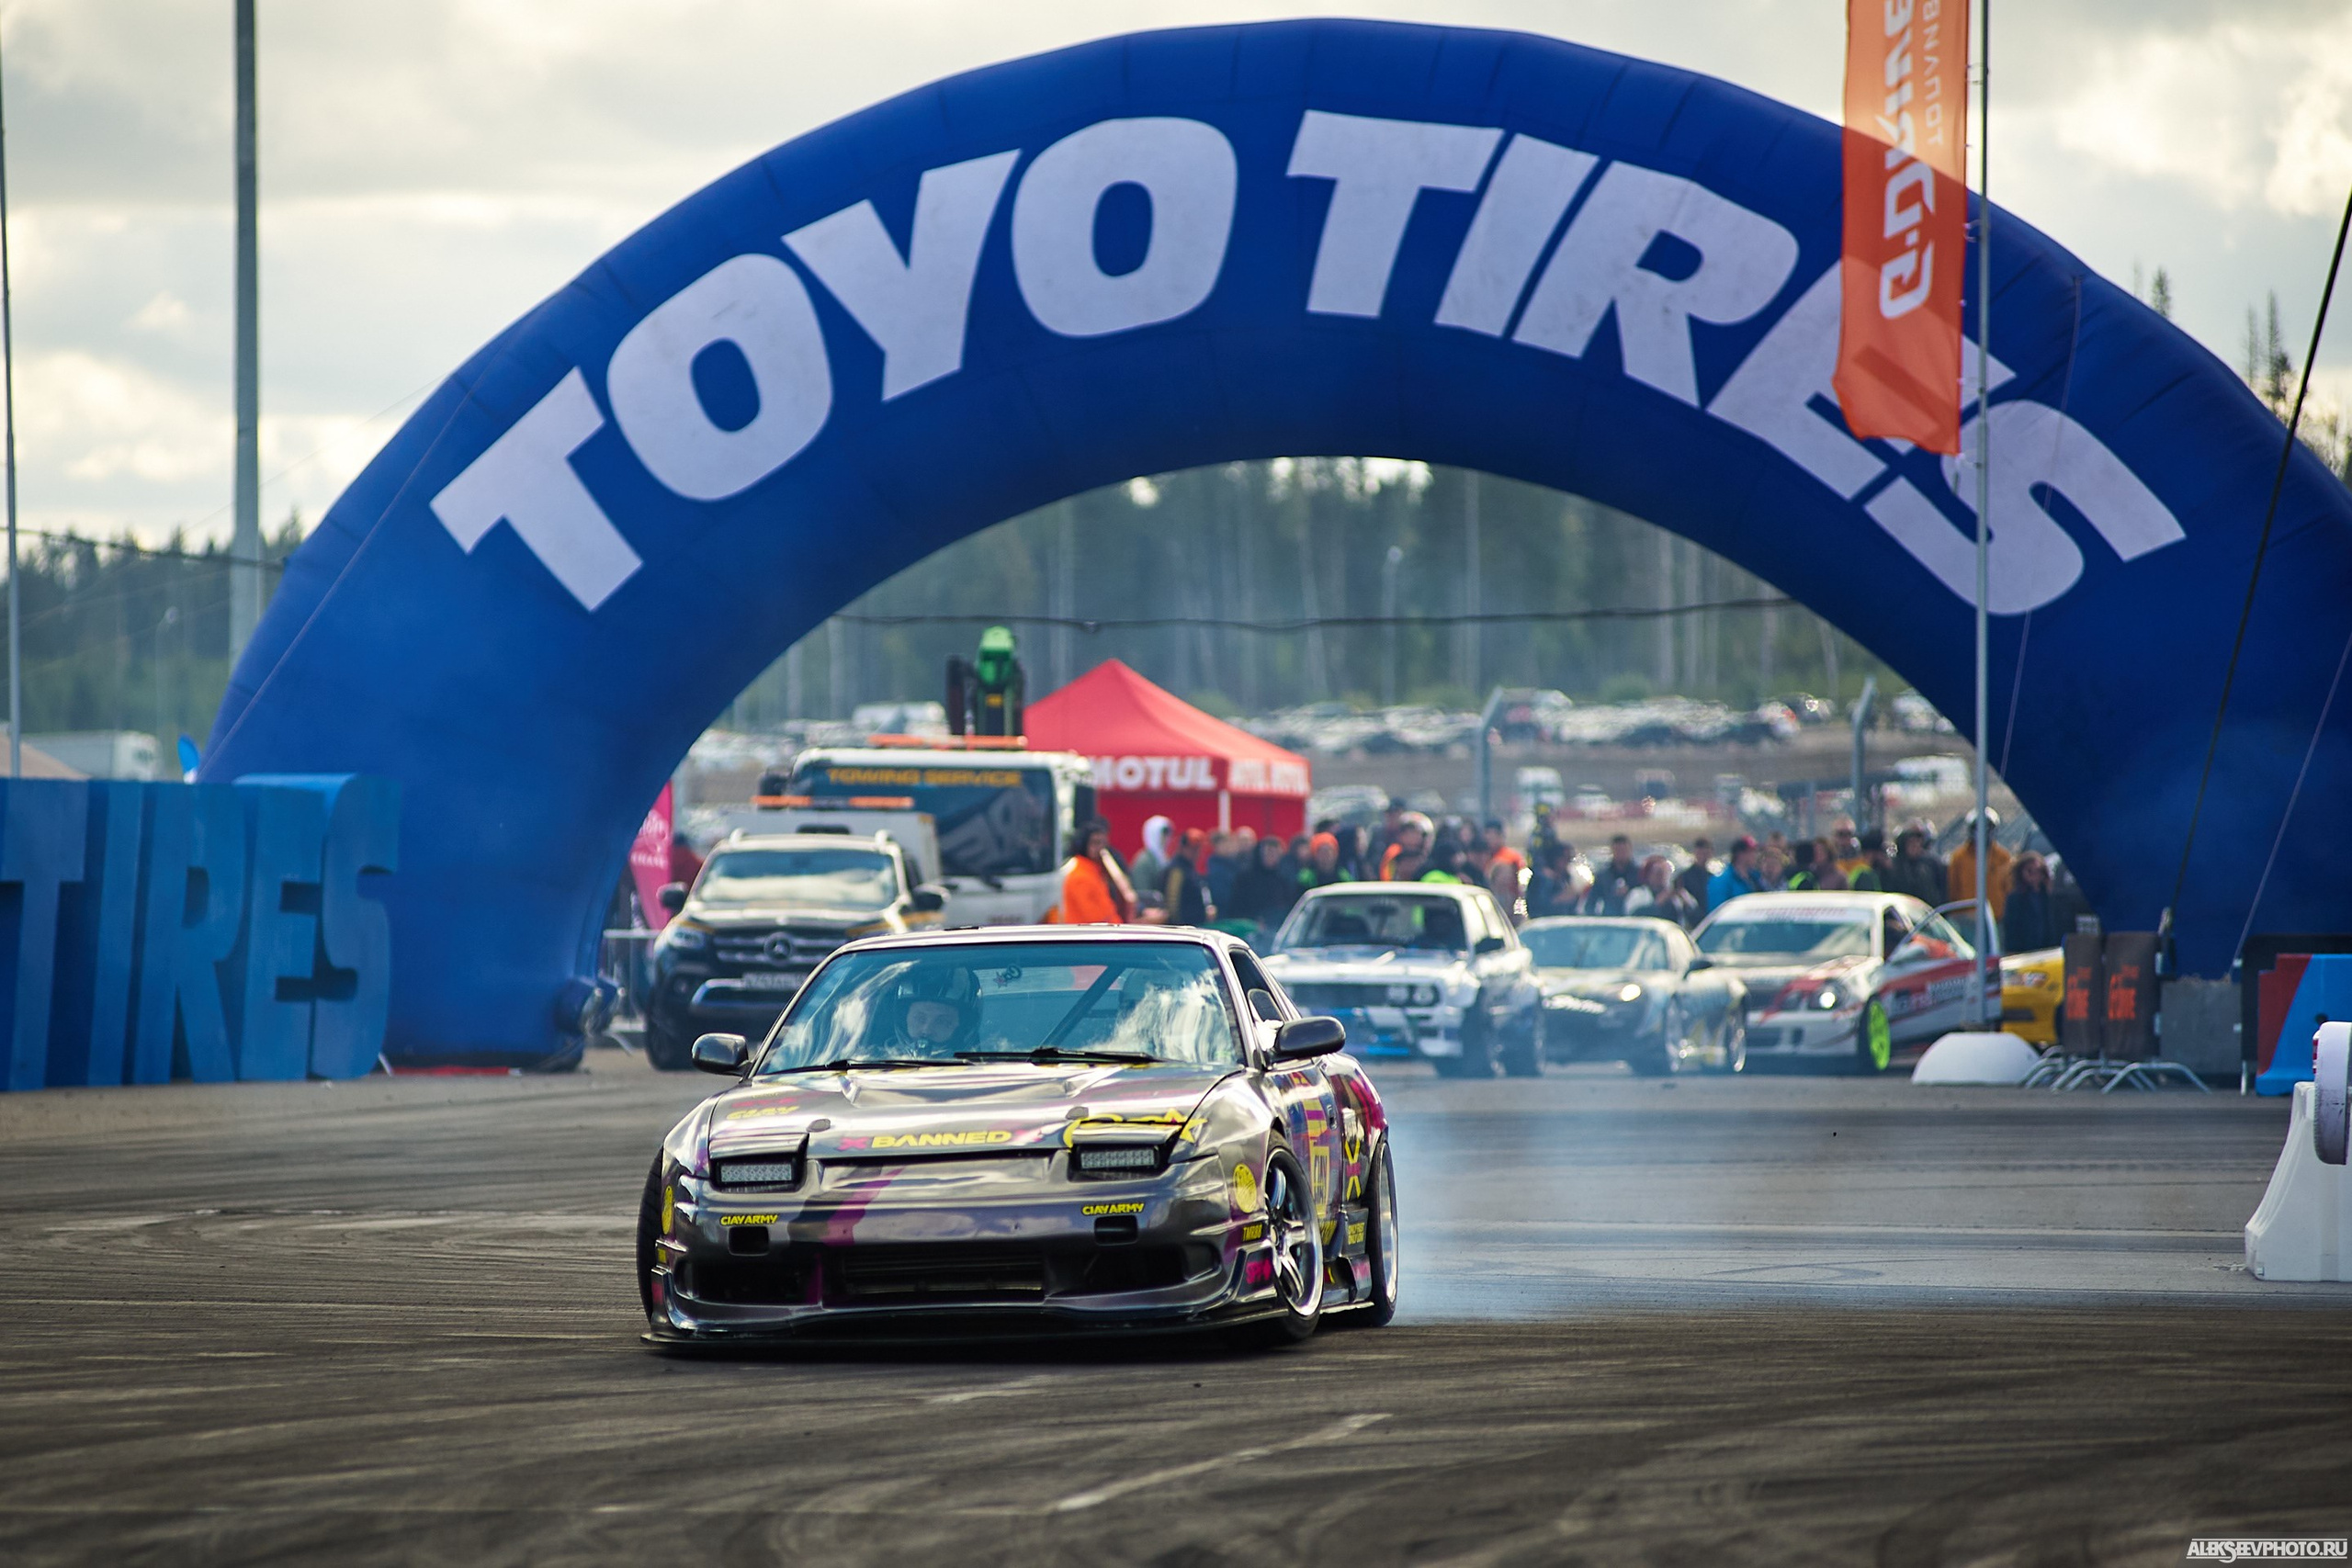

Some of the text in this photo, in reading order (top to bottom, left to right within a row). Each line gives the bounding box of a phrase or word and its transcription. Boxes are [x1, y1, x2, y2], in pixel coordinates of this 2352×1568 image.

[429, 108, 2186, 616] TOYO TIRES
[828, 768, 1022, 787] TOWING SERVICE
[1088, 756, 1216, 790] MOTUL
[0, 775, 402, 1091] TIRES
[871, 1131, 1012, 1148] BANNED
